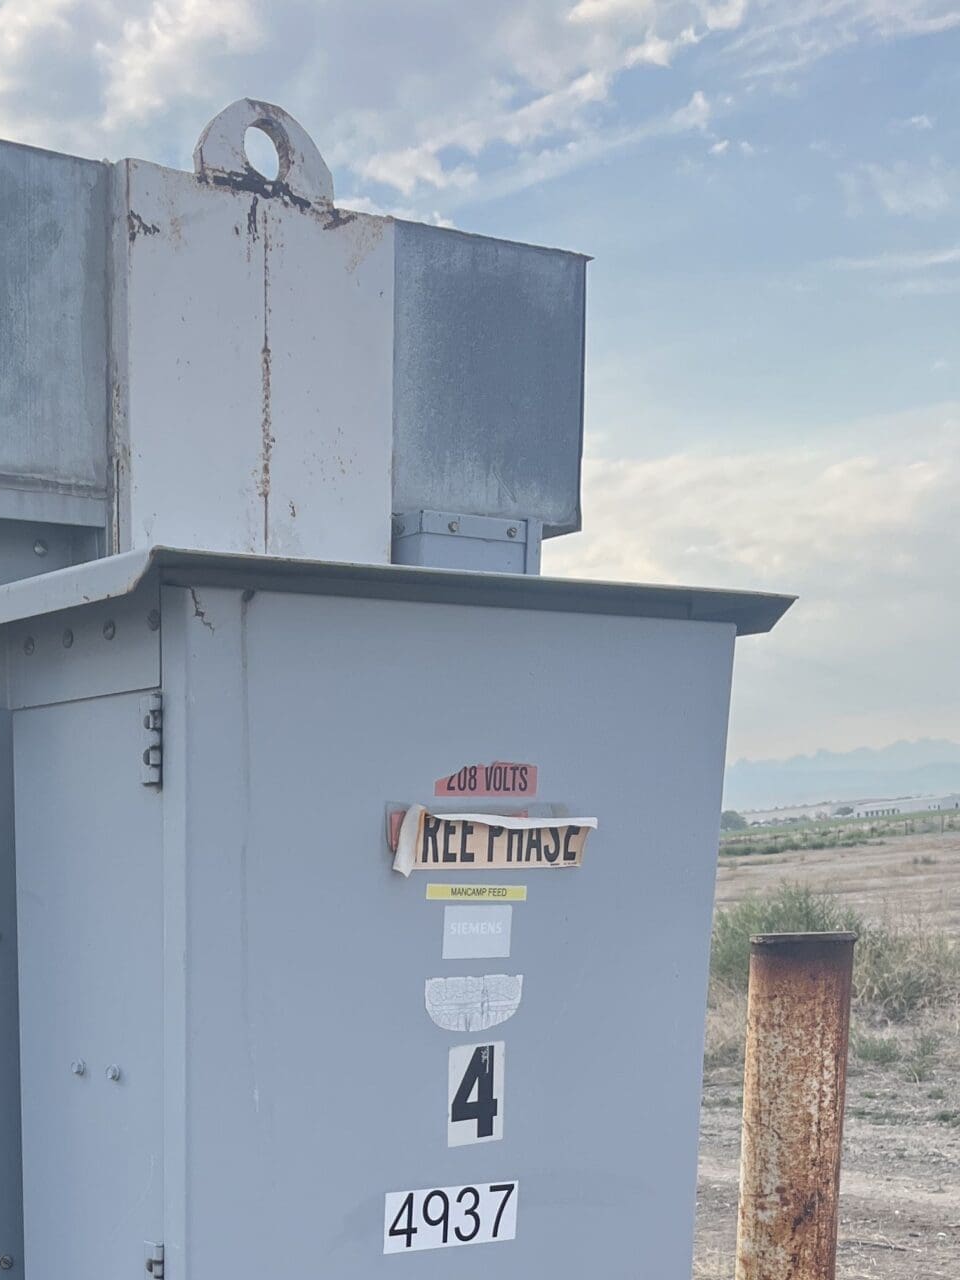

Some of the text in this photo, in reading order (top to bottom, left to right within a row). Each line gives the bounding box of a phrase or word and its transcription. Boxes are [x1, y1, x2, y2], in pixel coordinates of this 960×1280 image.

[484, 765, 528, 791] VOLTS
[421, 816, 475, 863] REE
[450, 887, 507, 897] MANCAMP FEED
[449, 921, 503, 935] SIEMENS
[450, 1044, 498, 1139] 4
[388, 1183, 516, 1248] 4937
